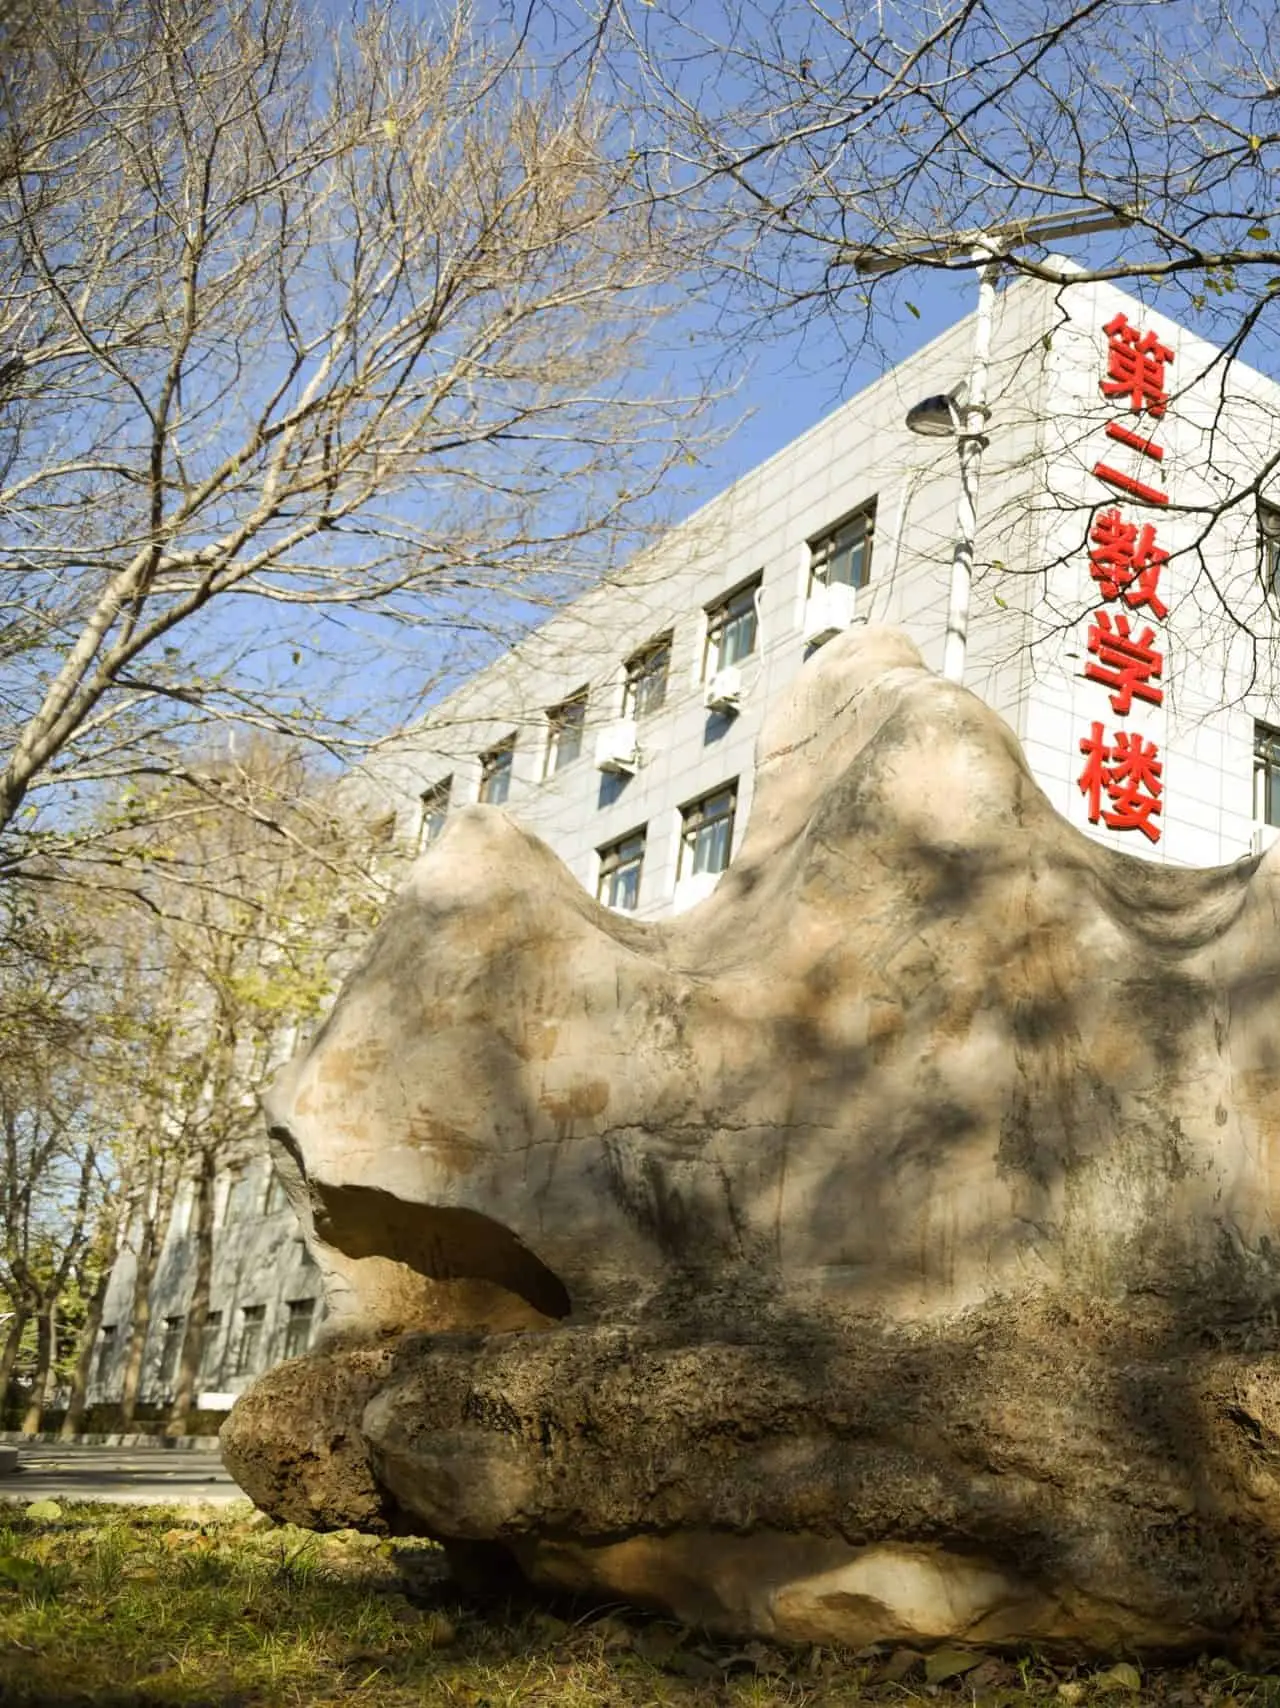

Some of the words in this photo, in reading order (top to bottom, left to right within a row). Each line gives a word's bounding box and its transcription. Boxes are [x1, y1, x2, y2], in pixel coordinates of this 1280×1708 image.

[1078, 312, 1175, 843] 第二教学楼
